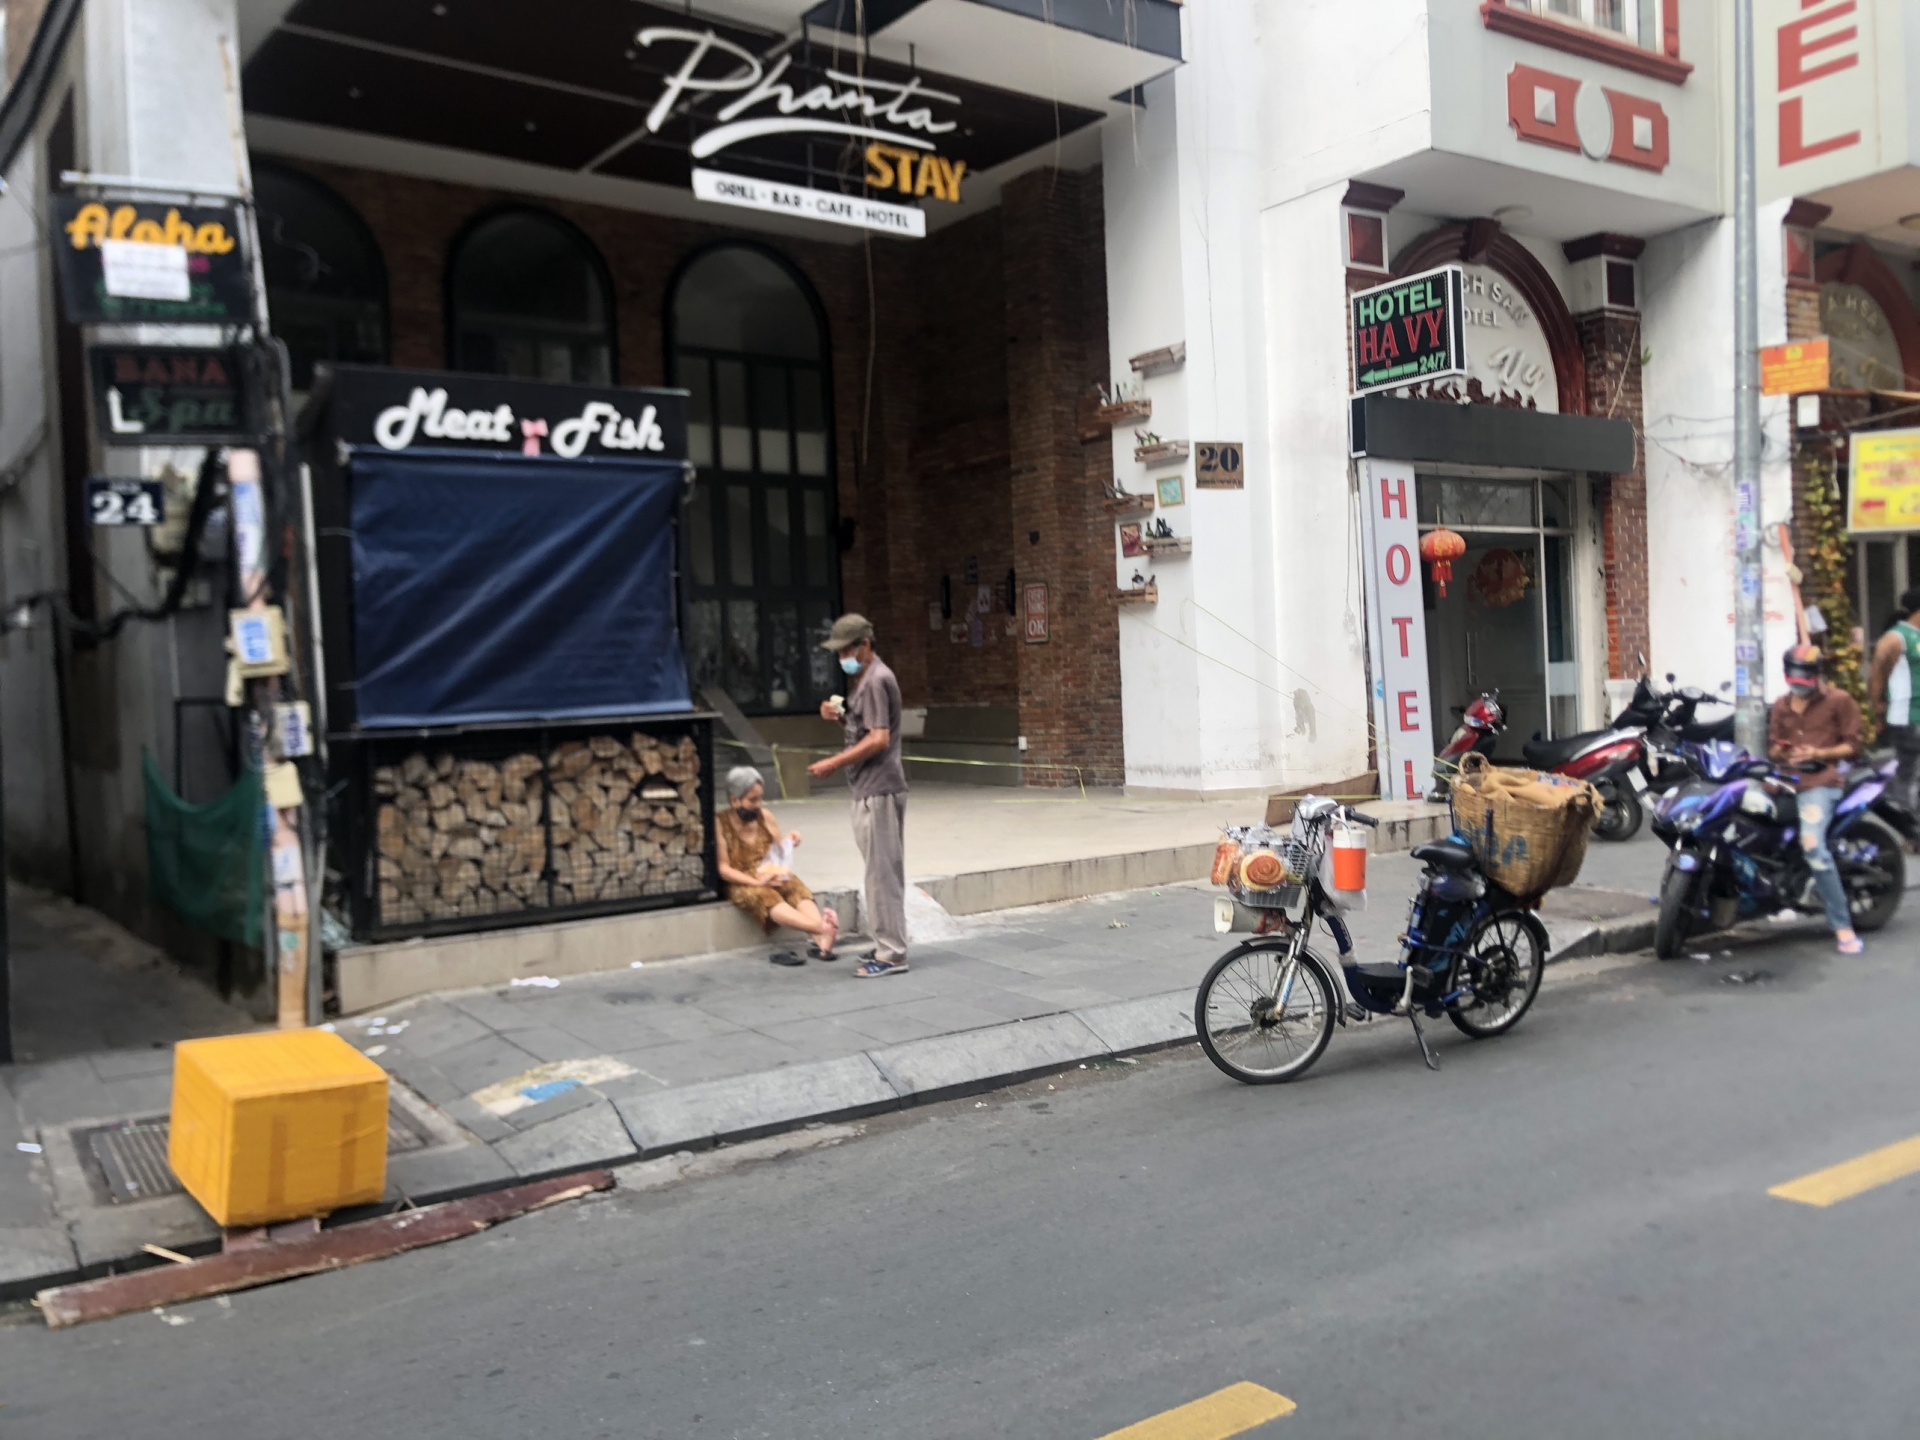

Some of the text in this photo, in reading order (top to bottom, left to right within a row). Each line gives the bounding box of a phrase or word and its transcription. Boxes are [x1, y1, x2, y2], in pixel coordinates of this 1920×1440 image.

[636, 27, 962, 133] Phanta
[865, 143, 967, 203] STAY
[66, 203, 235, 255] Aloha
[772, 190, 802, 208] BAR
[815, 198, 853, 219] CAFE
[864, 209, 910, 229] HOTEL
[1359, 280, 1442, 328] HOTEL
[1358, 306, 1445, 369] HẠ VY
[1419, 350, 1447, 374] 24/7
[373, 385, 515, 451] Meat
[551, 401, 665, 459] Fish
[1199, 445, 1240, 473] 20
[91, 490, 159, 525] 24
[1028, 619, 1046, 636] OK
[1379, 477, 1424, 800] HOTEL
